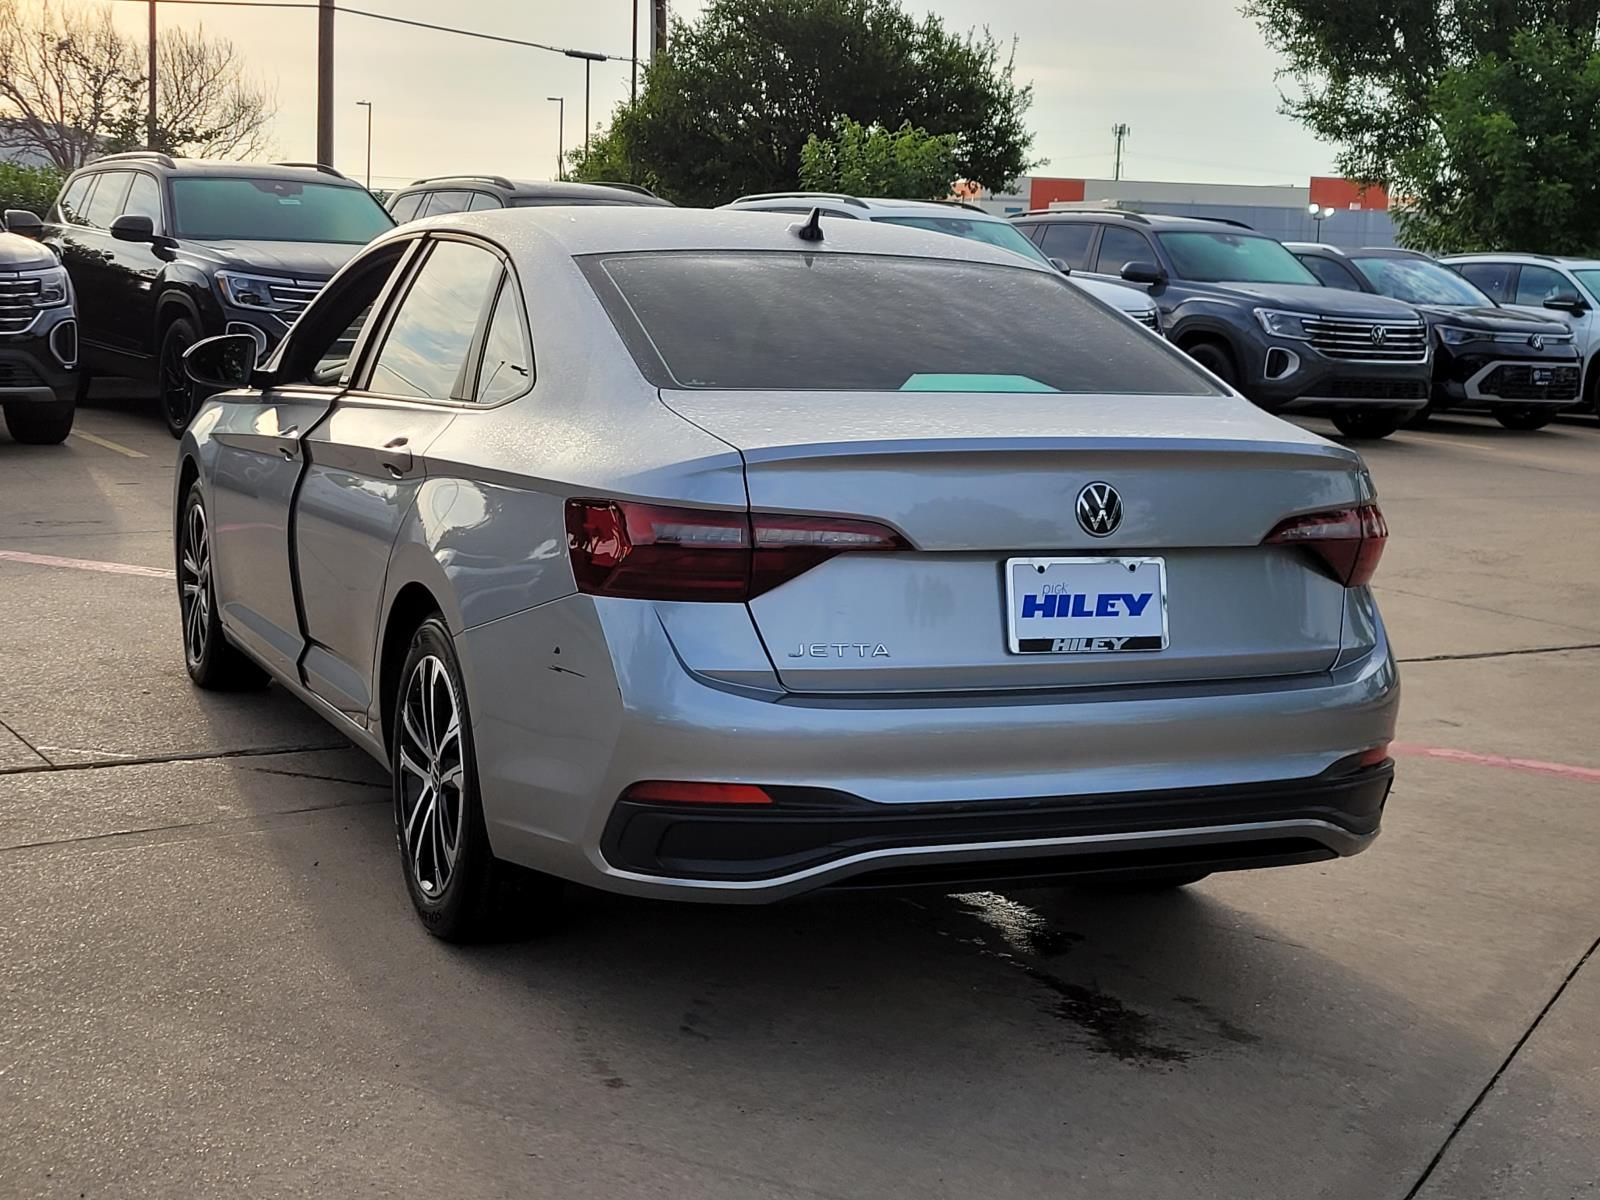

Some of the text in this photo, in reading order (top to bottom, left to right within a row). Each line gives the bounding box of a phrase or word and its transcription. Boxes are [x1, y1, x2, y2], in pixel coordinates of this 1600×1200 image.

[1042, 582, 1068, 594] pick
[1021, 593, 1152, 618] HILEY
[788, 642, 891, 658] JETTA
[1051, 638, 1130, 651] HILEY
